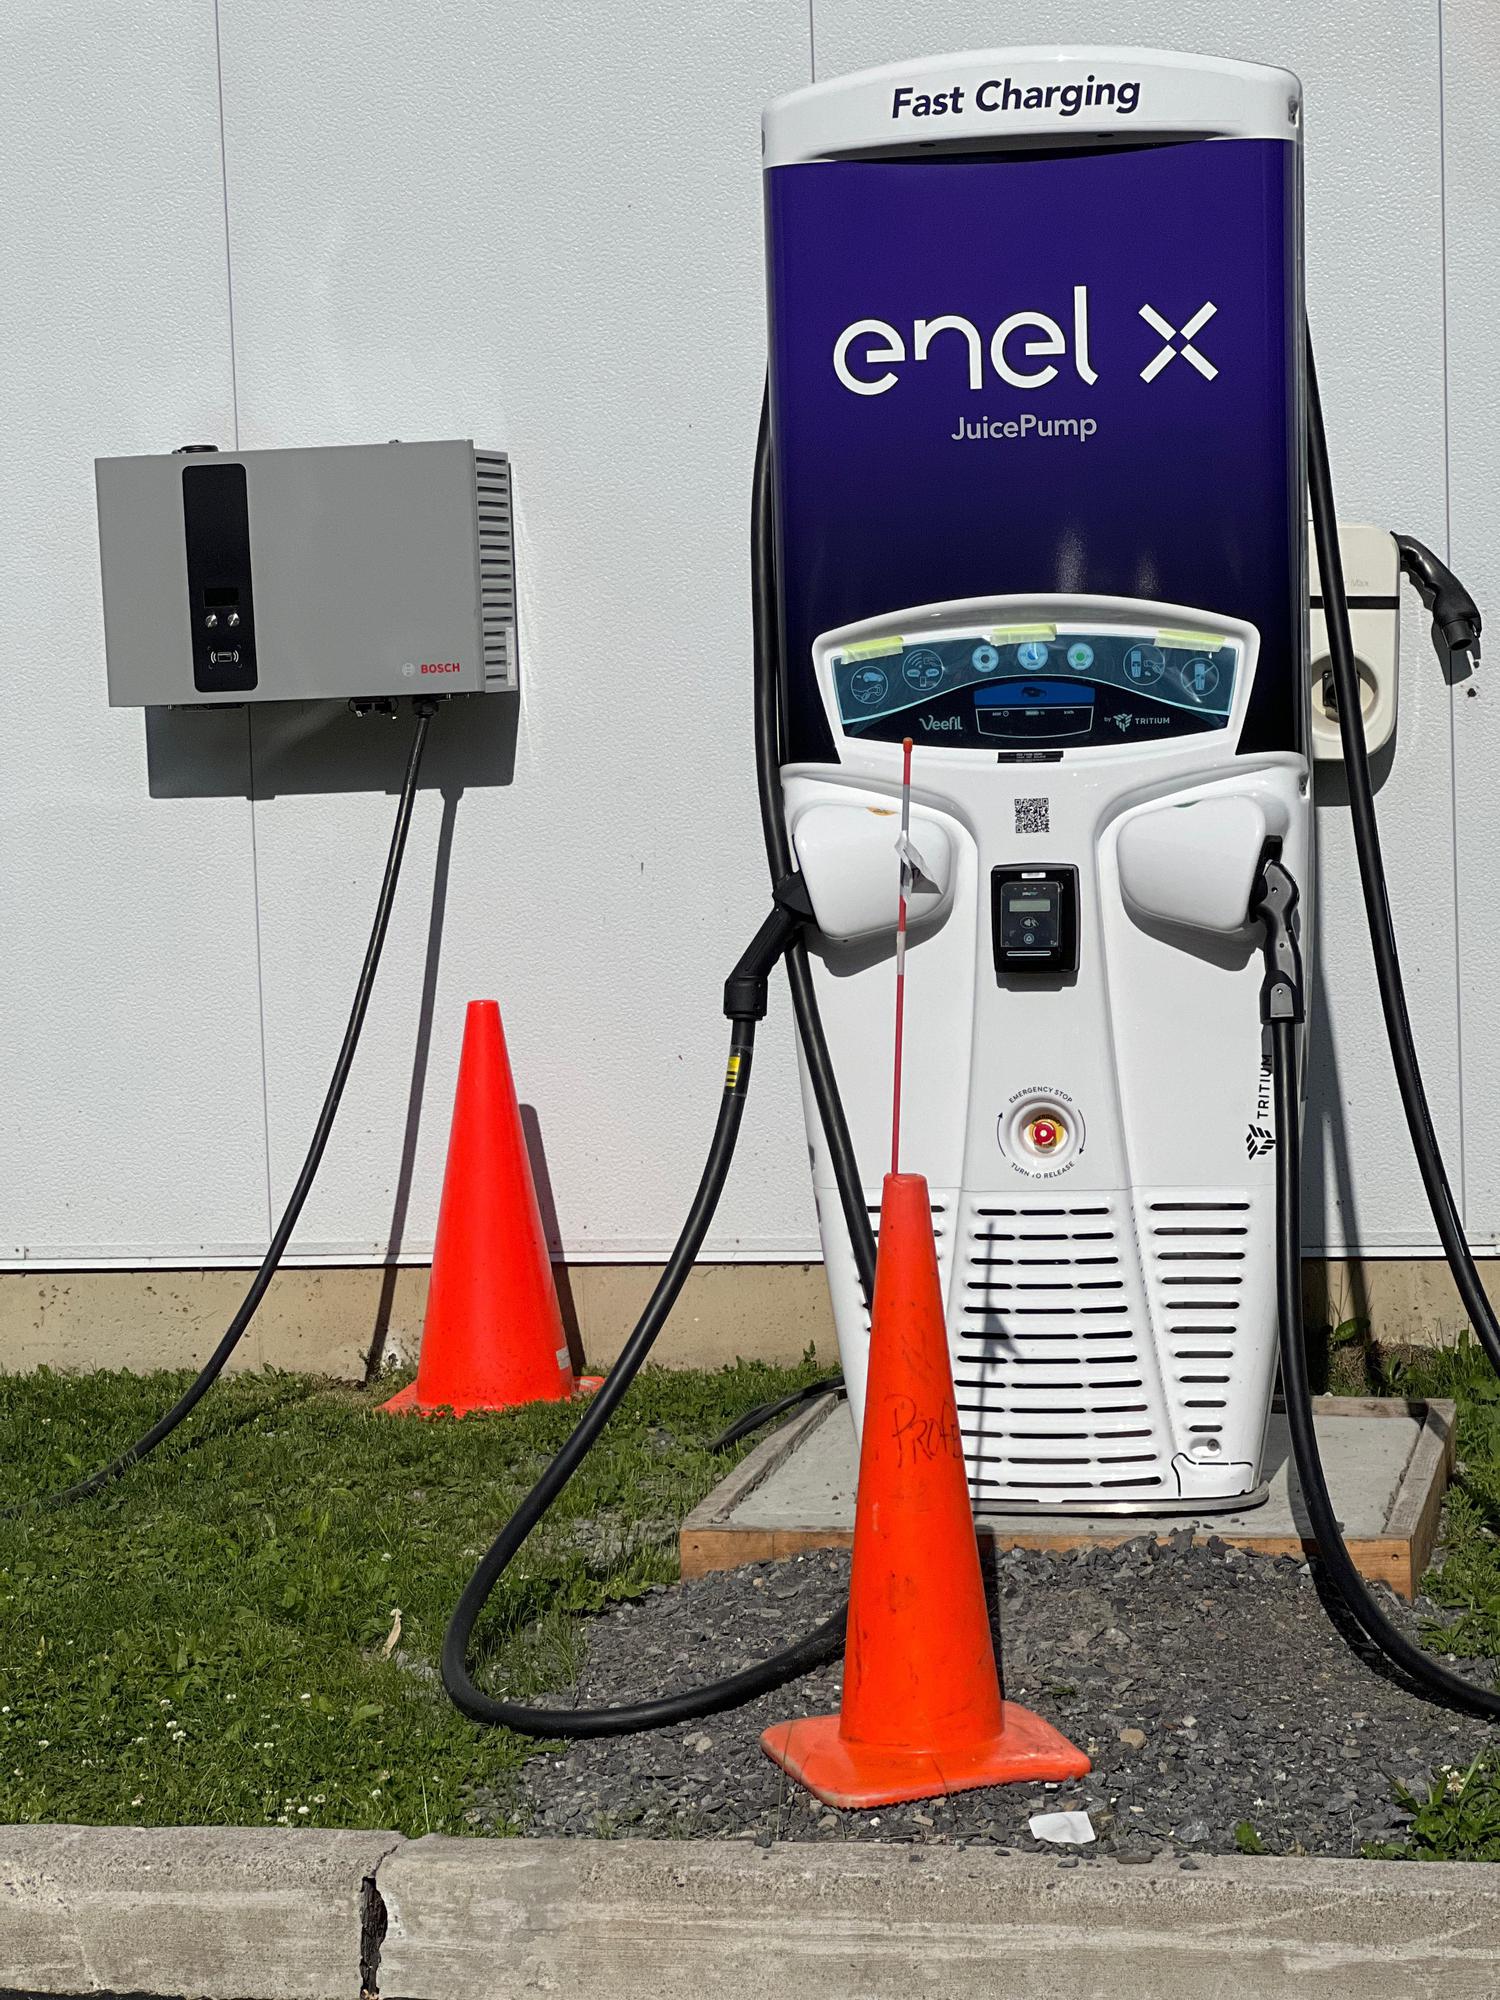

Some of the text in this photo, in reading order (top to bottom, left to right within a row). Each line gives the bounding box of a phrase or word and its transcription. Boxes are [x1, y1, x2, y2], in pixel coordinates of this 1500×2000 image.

[892, 75, 1141, 119] Fast Charging
[833, 285, 1098, 396] enel
[951, 414, 1098, 442] JuicePump
[421, 663, 460, 674] BOSCH
[918, 714, 963, 730] Veefil
[1135, 716, 1170, 725] TRITIUM
[1008, 1086, 1073, 1104] EMERGENCY STOP
[1256, 1054, 1273, 1120] TRITIUM
[1011, 1162, 1030, 1177] TURN
[1043, 1160, 1075, 1179] RELEASE
